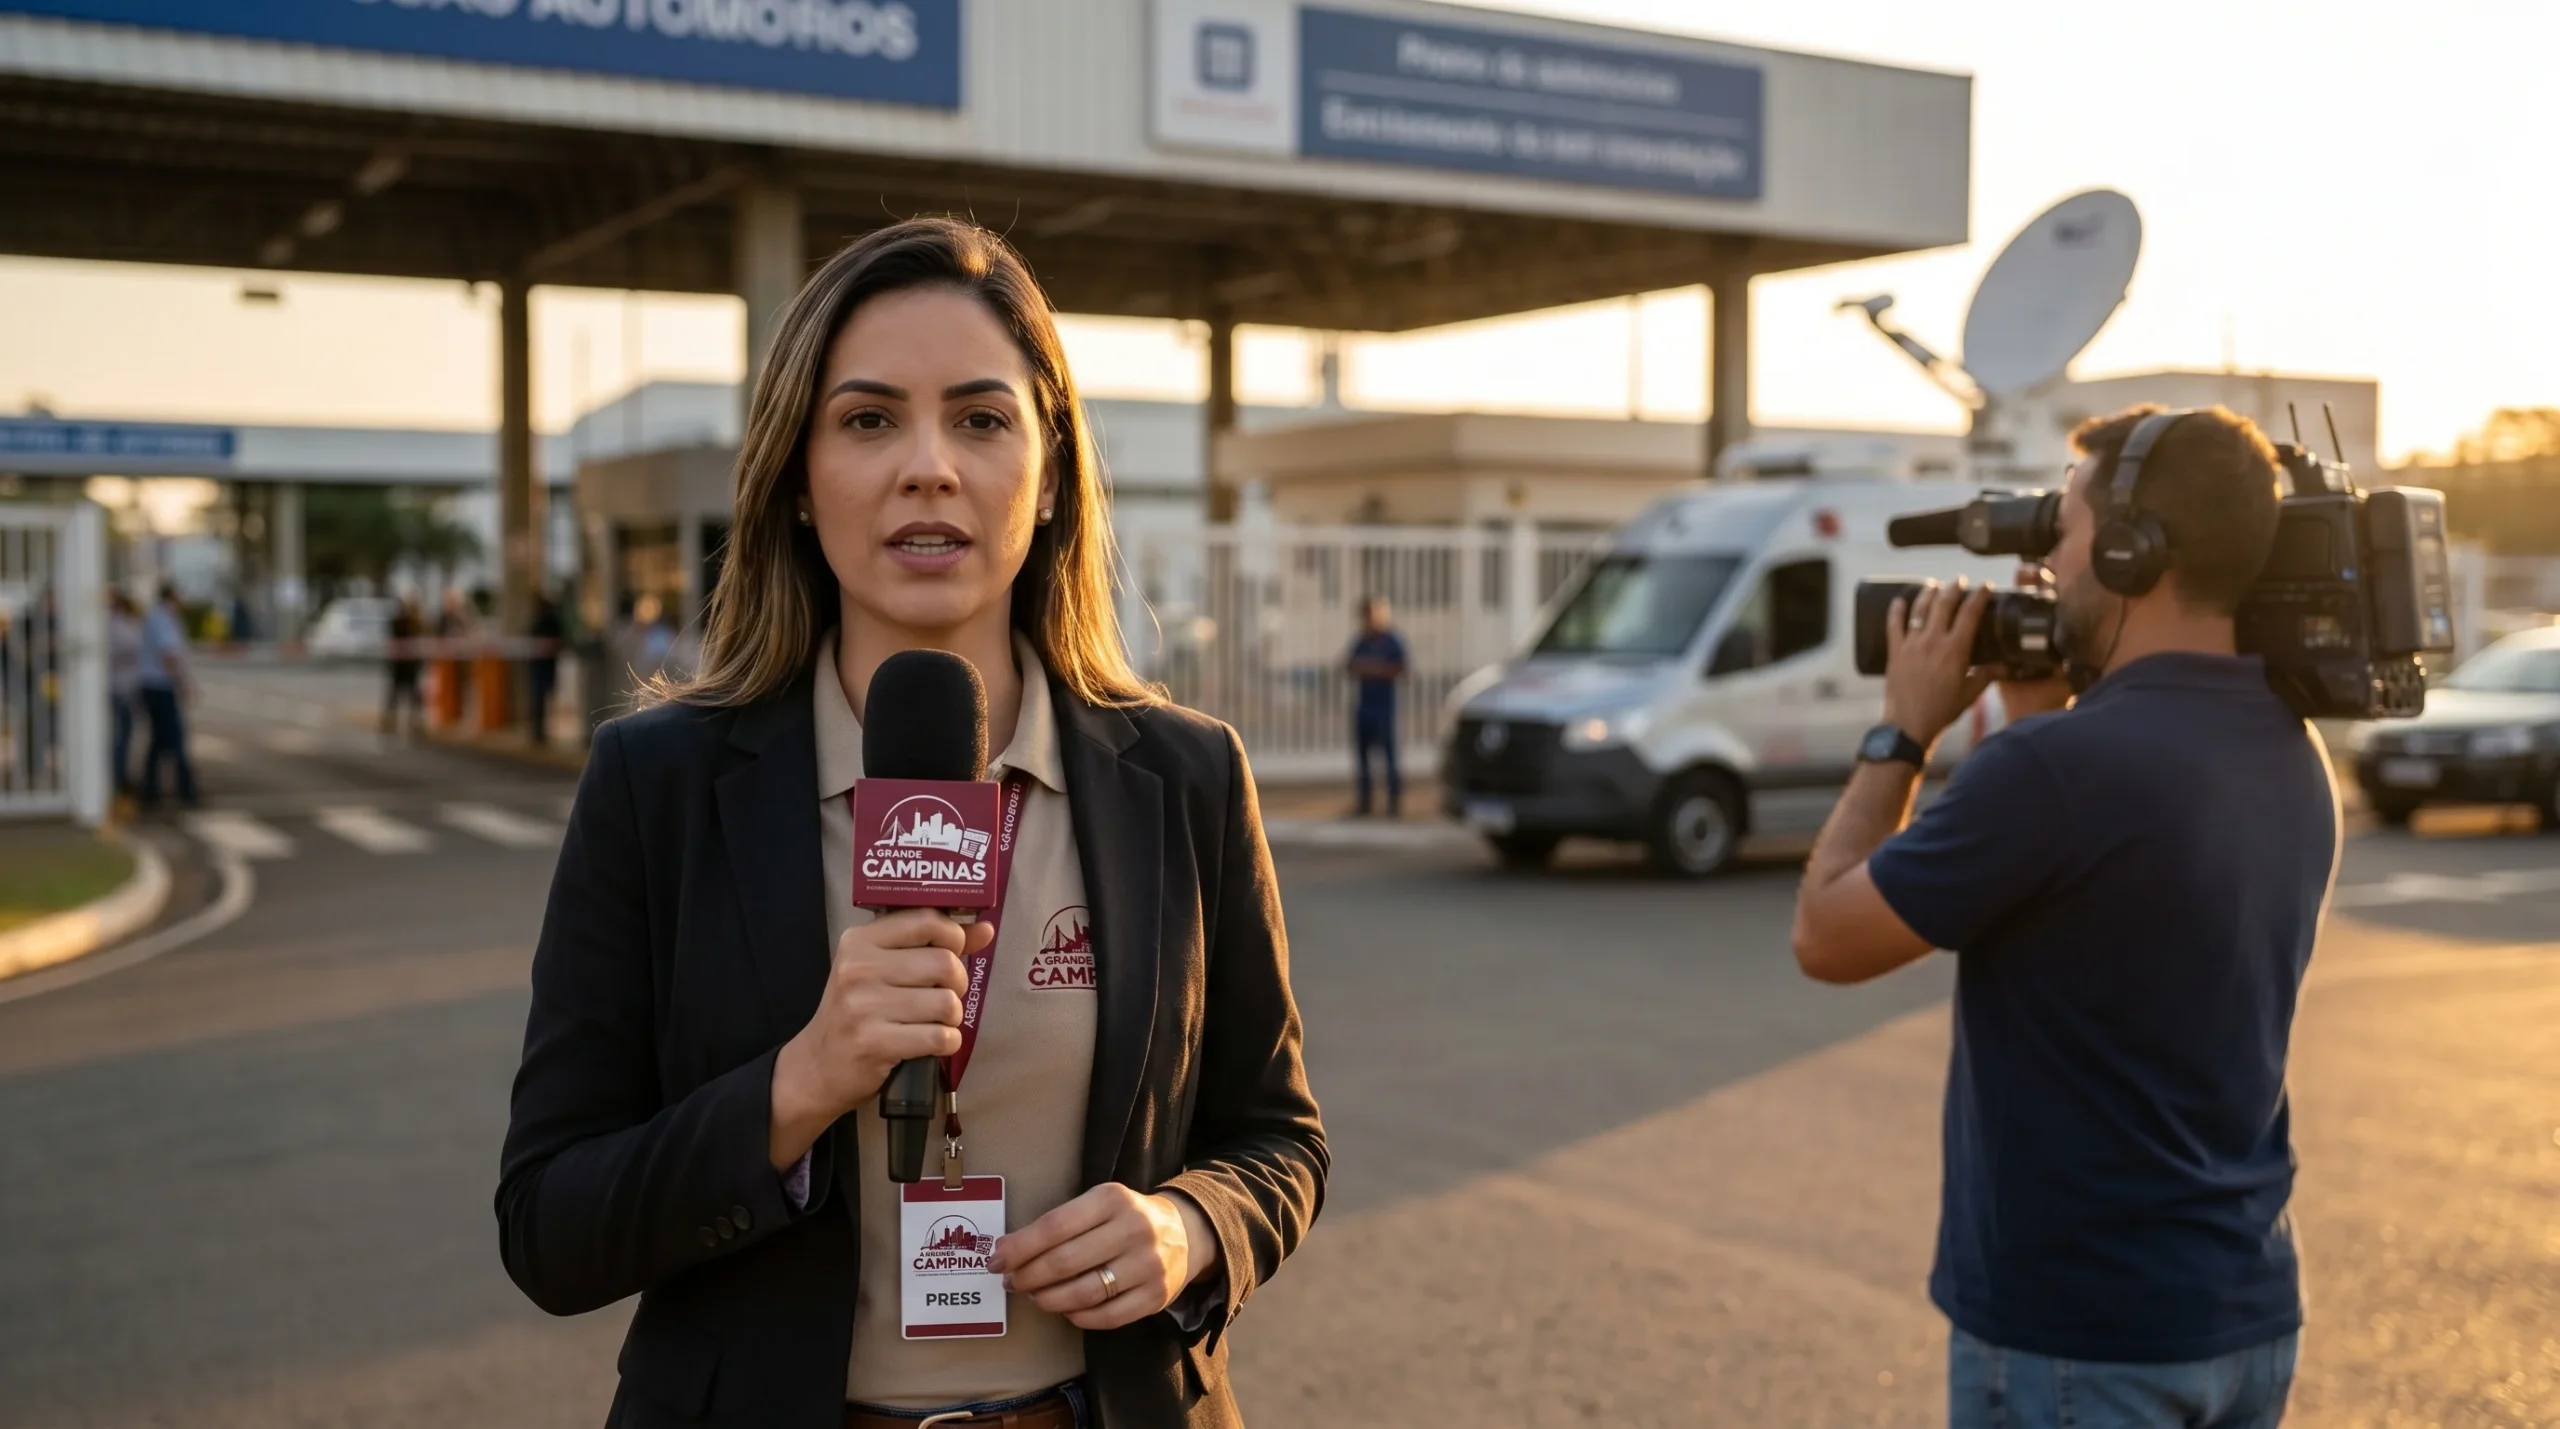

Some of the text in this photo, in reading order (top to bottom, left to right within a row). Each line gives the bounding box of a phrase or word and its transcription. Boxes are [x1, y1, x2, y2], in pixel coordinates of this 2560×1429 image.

[866, 849, 922, 859] A GRANDE
[862, 859, 986, 881] CAMPINAS
[1032, 956, 1093, 965] A GRANDE
[926, 1292, 981, 1306] PRESS
